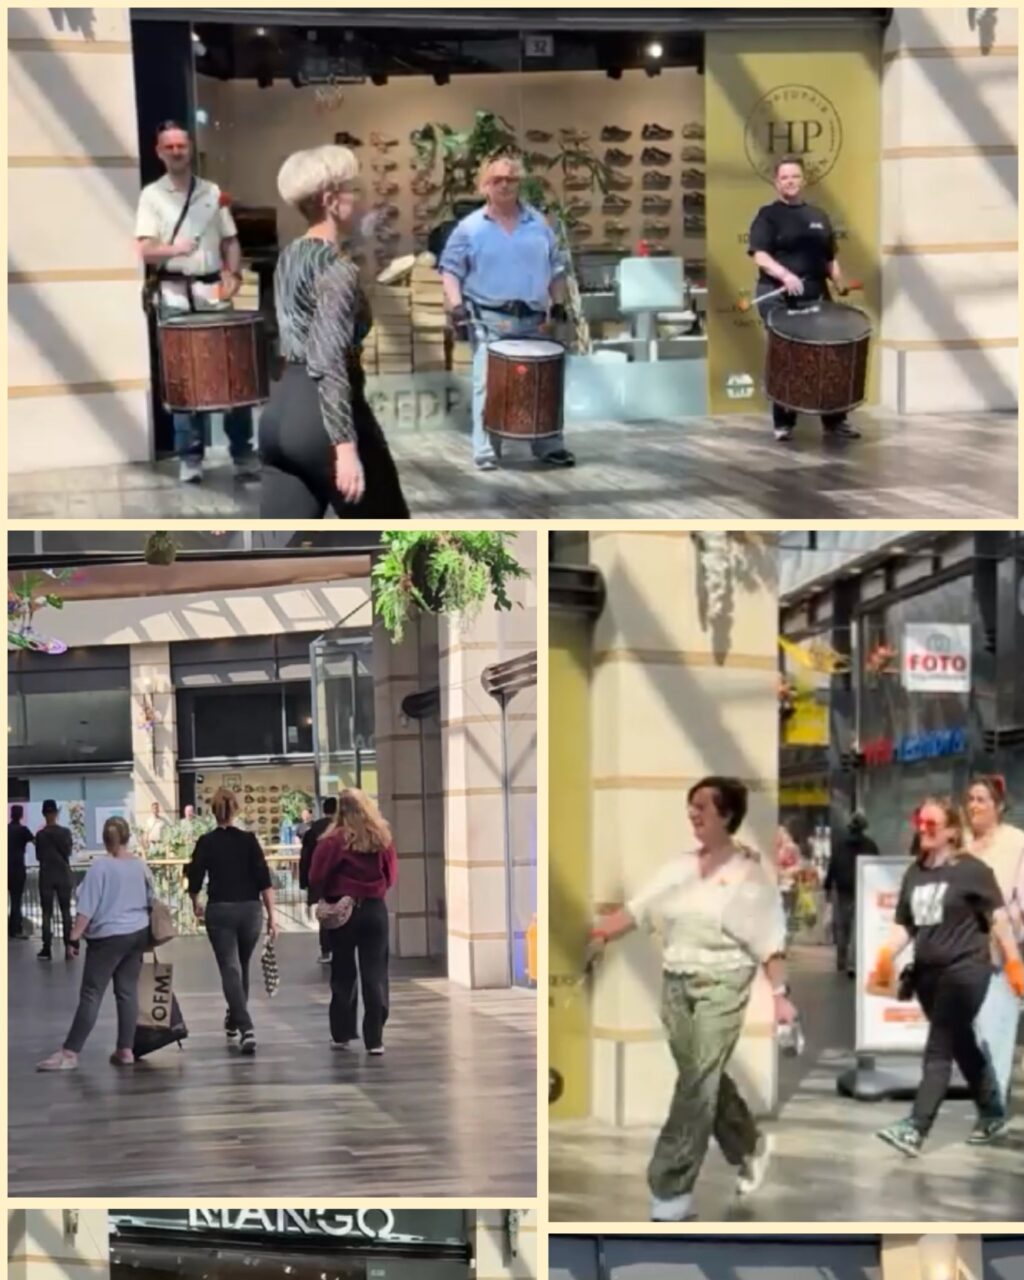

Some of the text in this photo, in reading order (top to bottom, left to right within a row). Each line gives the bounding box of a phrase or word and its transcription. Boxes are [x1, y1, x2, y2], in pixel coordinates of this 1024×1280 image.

[767, 119, 823, 154] HP
[909, 654, 967, 673] FOTO
[151, 967, 172, 1022] OFM.
